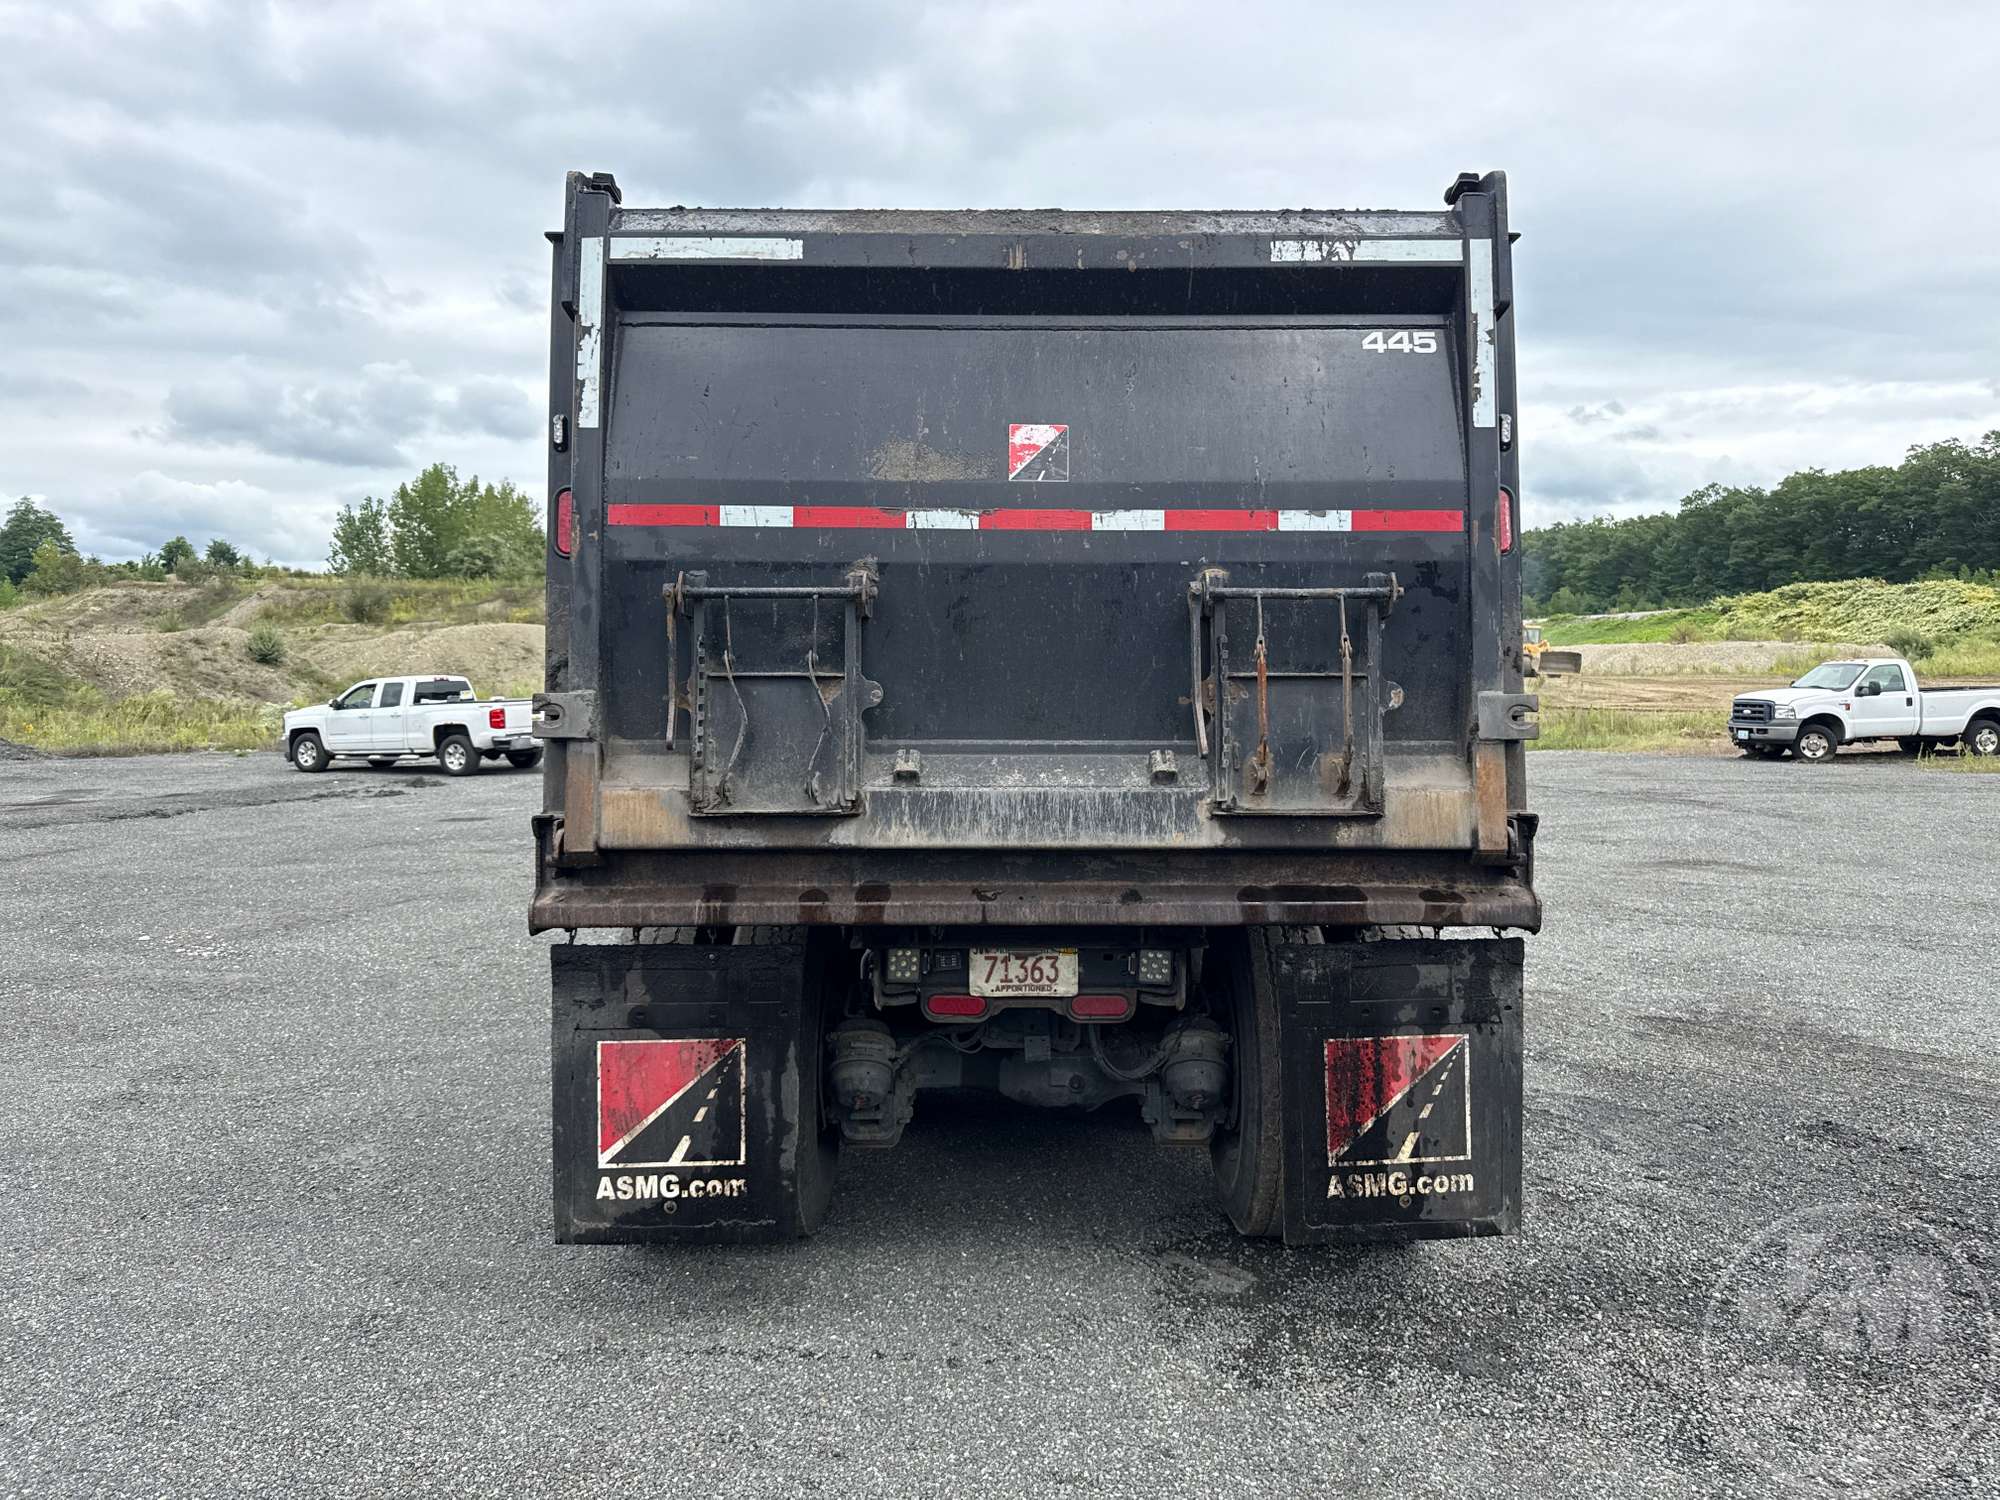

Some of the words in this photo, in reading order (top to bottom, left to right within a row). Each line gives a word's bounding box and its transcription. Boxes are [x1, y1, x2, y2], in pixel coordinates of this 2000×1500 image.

[1361, 331, 1437, 354] 445
[983, 955, 1059, 984] 71363
[596, 1174, 748, 1200] ASMG.com
[1326, 1171, 1475, 1199] ASMG.com
